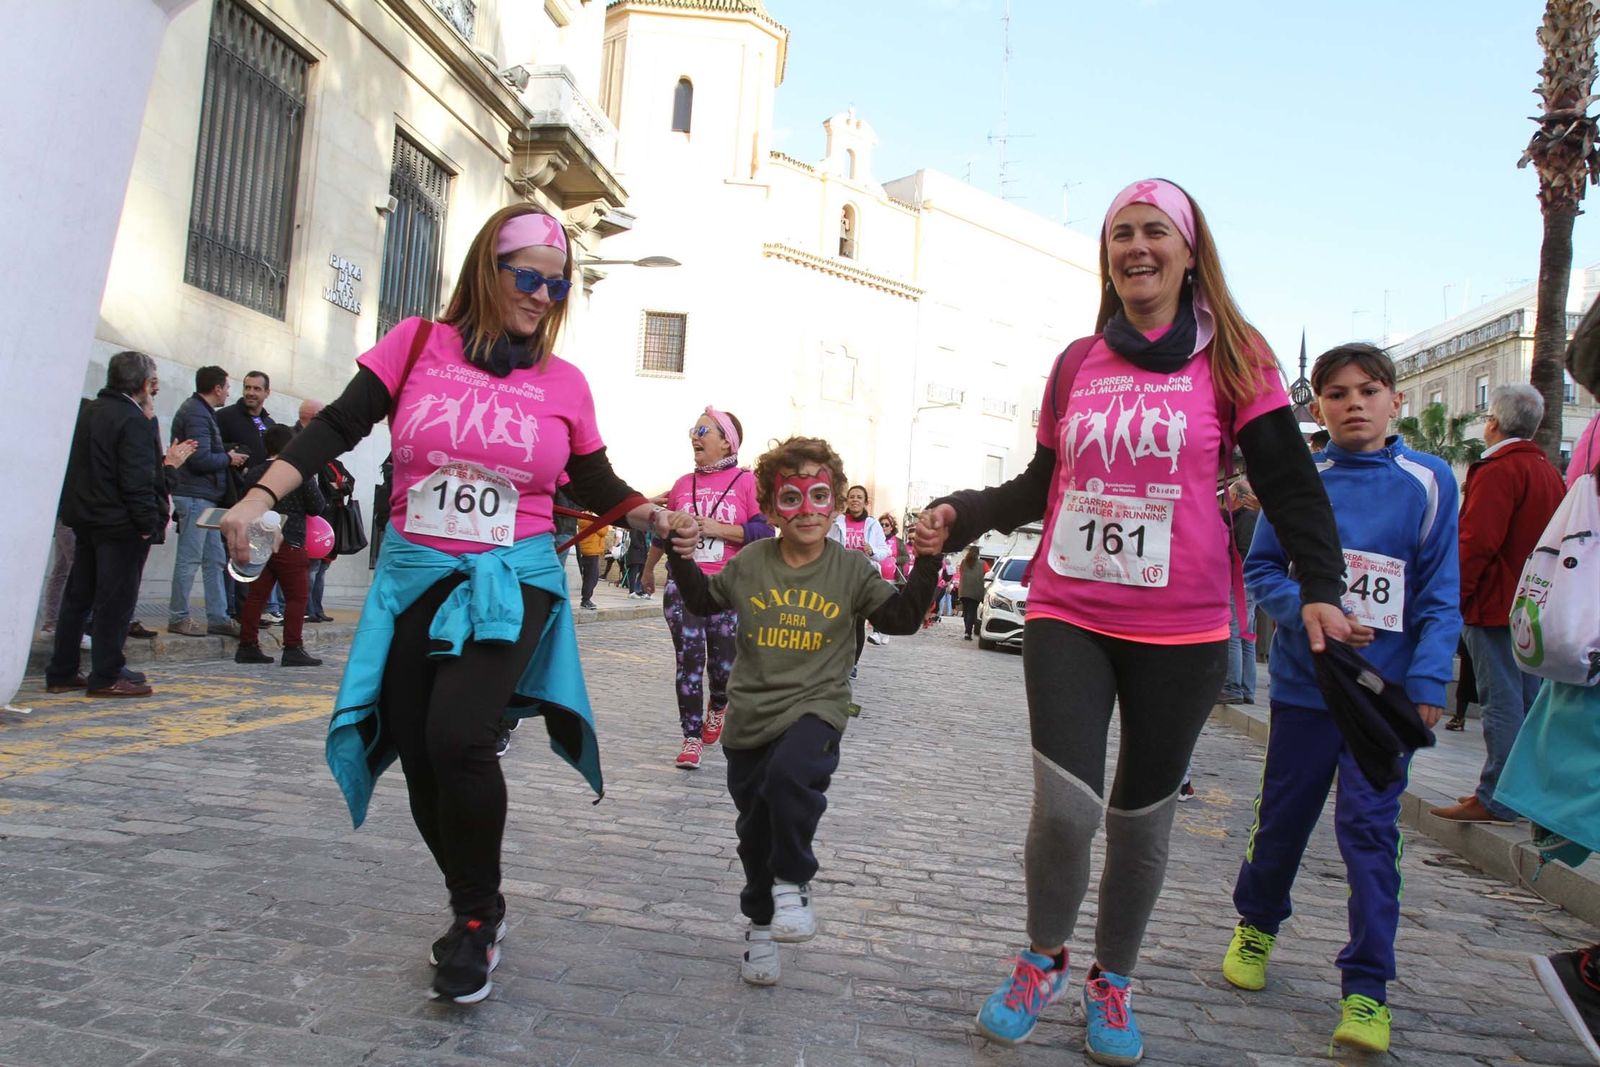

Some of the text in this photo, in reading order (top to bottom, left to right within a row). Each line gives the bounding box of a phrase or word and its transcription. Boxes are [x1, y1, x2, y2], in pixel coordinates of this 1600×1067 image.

[331, 254, 361, 280] PLAZA
[340, 270, 351, 286] DE
[336, 279, 354, 299] LAS
[323, 288, 361, 313] MONJAS
[426, 368, 439, 377] DE
[439, 371, 451, 380] LA
[453, 373, 489, 388] MUJER
[498, 383, 545, 402] RUNNING
[446, 364, 545, 396] CARRERA PINK
[1072, 383, 1193, 398] DE LA MUJER & RUNNING
[1090, 375, 1192, 388] CARRERA PINK
[432, 480, 500, 518] 160
[1149, 486, 1180, 495] ekiden
[1075, 504, 1084, 513] LA
[1123, 510, 1167, 522] RUNNING
[1145, 503, 1167, 513] PINK
[1079, 519, 1145, 558] 161
[750, 588, 840, 619] NACIDO
[779, 612, 807, 628] PARA
[757, 626, 823, 651] LUCHAR
